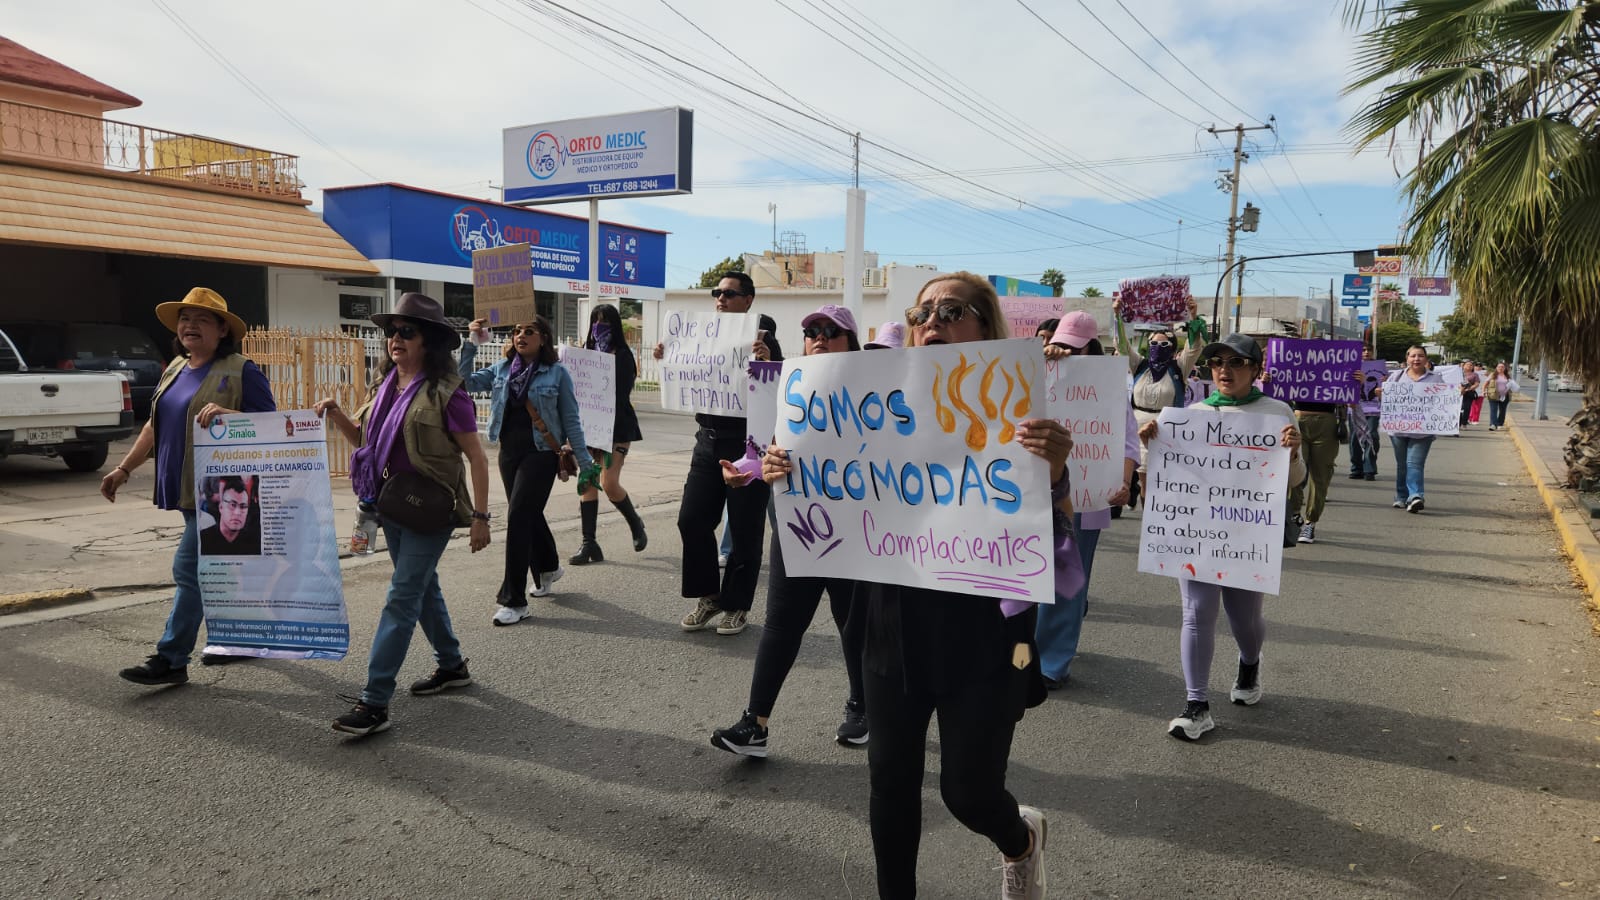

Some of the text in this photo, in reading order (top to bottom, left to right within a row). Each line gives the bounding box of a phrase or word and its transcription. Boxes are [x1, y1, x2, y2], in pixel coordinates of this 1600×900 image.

[569, 130, 646, 153] ORTO MEDIC
[572, 151, 644, 165] DISTRIBUIDORA DE EQUIPO
[588, 179, 658, 193] TEL:687 688 1244
[536, 260, 541, 268] Y
[541, 262, 575, 272] ORTOPÉDICO
[552, 253, 560, 261] DE
[560, 254, 580, 264] EQUIPO
[614, 286, 629, 295] 1244
[668, 313, 721, 338] Que el
[668, 341, 726, 376] Privilegio
[1306, 348, 1358, 365] MARCHO
[679, 368, 711, 381] nuble
[719, 370, 730, 385] la
[1269, 367, 1350, 383] POR LAS QUE
[1066, 385, 1098, 402] UNA
[1273, 384, 1355, 402] YA NO ESTÁN
[1383, 382, 1414, 396] CAUSA
[228, 428, 256, 439] Sinaloa
[1164, 419, 1277, 447] Tu México
[1383, 421, 1459, 431] VIOLADOR EN CASA
[265, 451, 271, 460] a
[273, 448, 318, 459] encontrar
[205, 464, 229, 474] JESUS
[230, 463, 273, 473] GUADALUPE
[275, 462, 313, 471] CAMARGO
[1080, 465, 1088, 480] Y
[782, 443, 1022, 514] INCÓMODAS
[1155, 472, 1275, 503] tiene primer
[1151, 496, 1278, 526] lugar MUNDIAL
[786, 502, 1047, 576] NO Complacientes
[1147, 523, 1229, 540] en abuso
[1147, 542, 1269, 563] sexual infantil
[235, 622, 271, 631] información
[266, 632, 273, 640] Tu
[275, 634, 293, 642] ayuda
